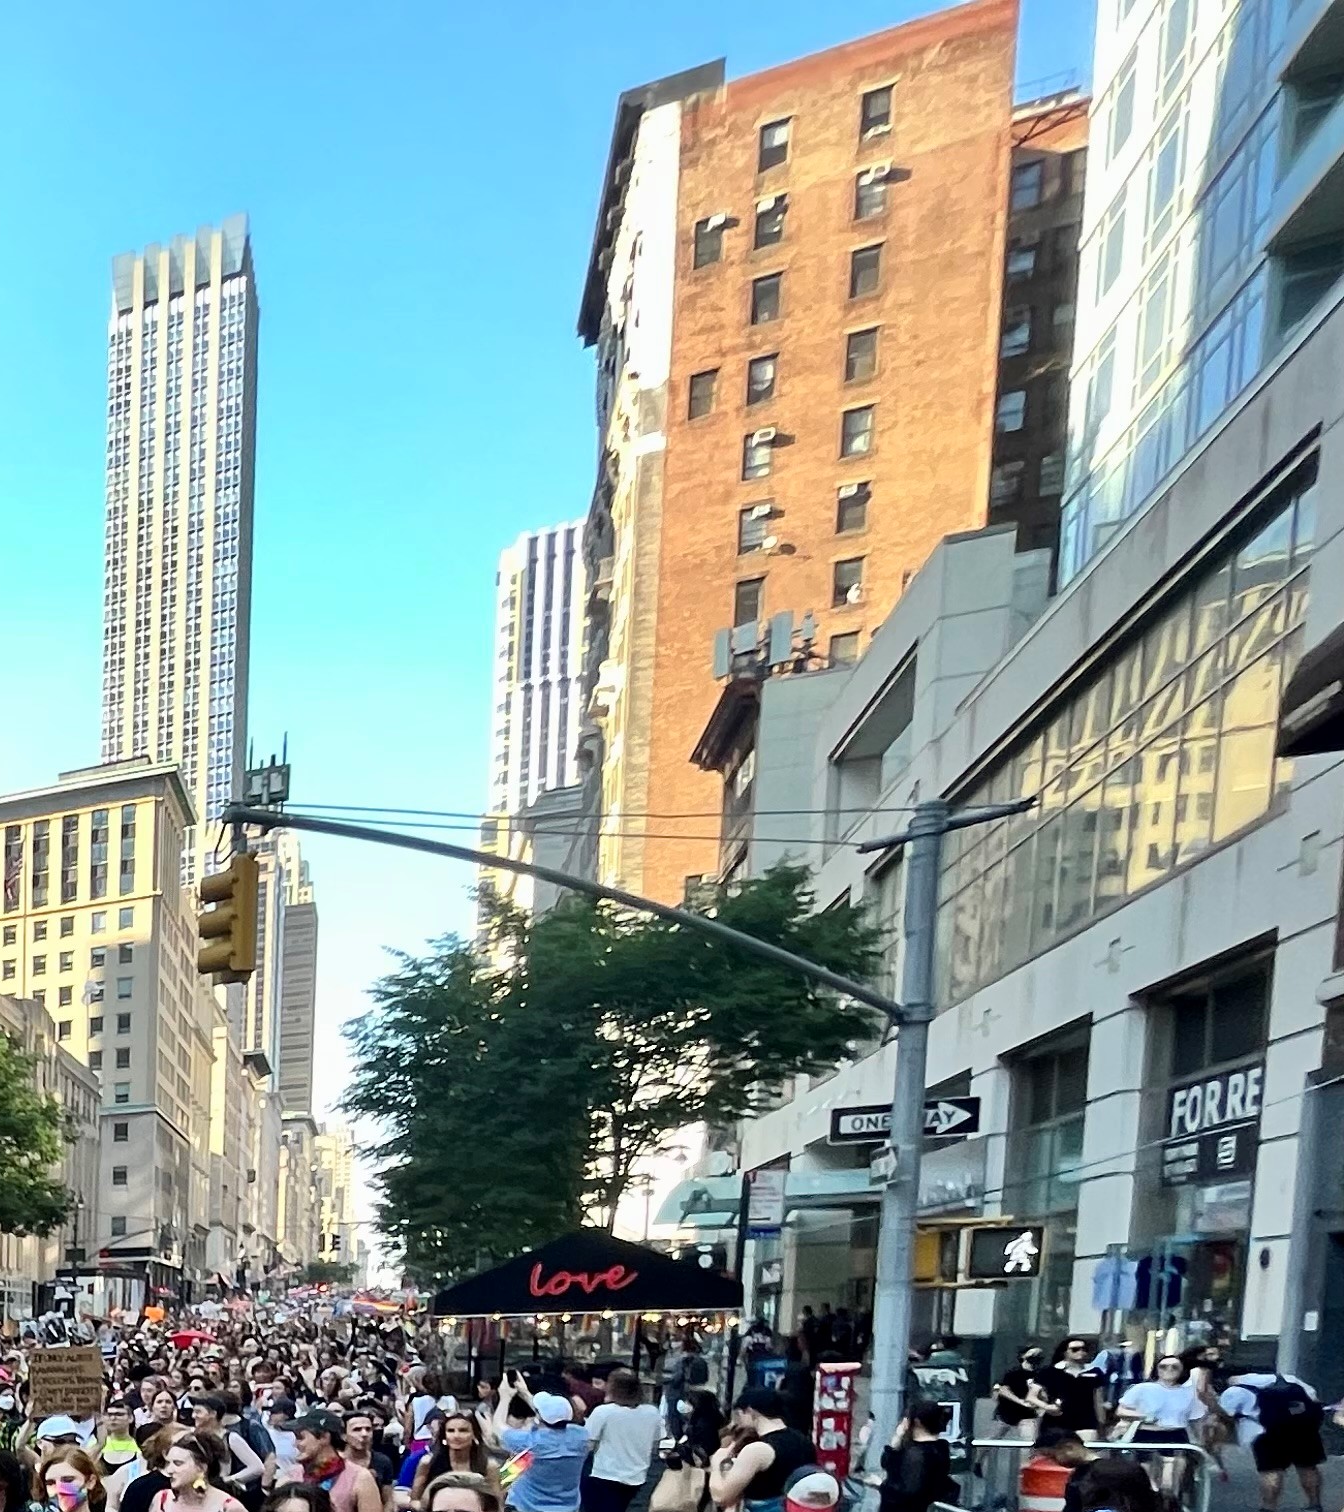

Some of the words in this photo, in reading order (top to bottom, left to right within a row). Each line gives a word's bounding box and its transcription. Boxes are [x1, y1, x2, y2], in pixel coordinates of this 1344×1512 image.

[851, 1114, 891, 1131] ONE
[1171, 1080, 1222, 1138] FOR
[1226, 1066, 1263, 1119] RE
